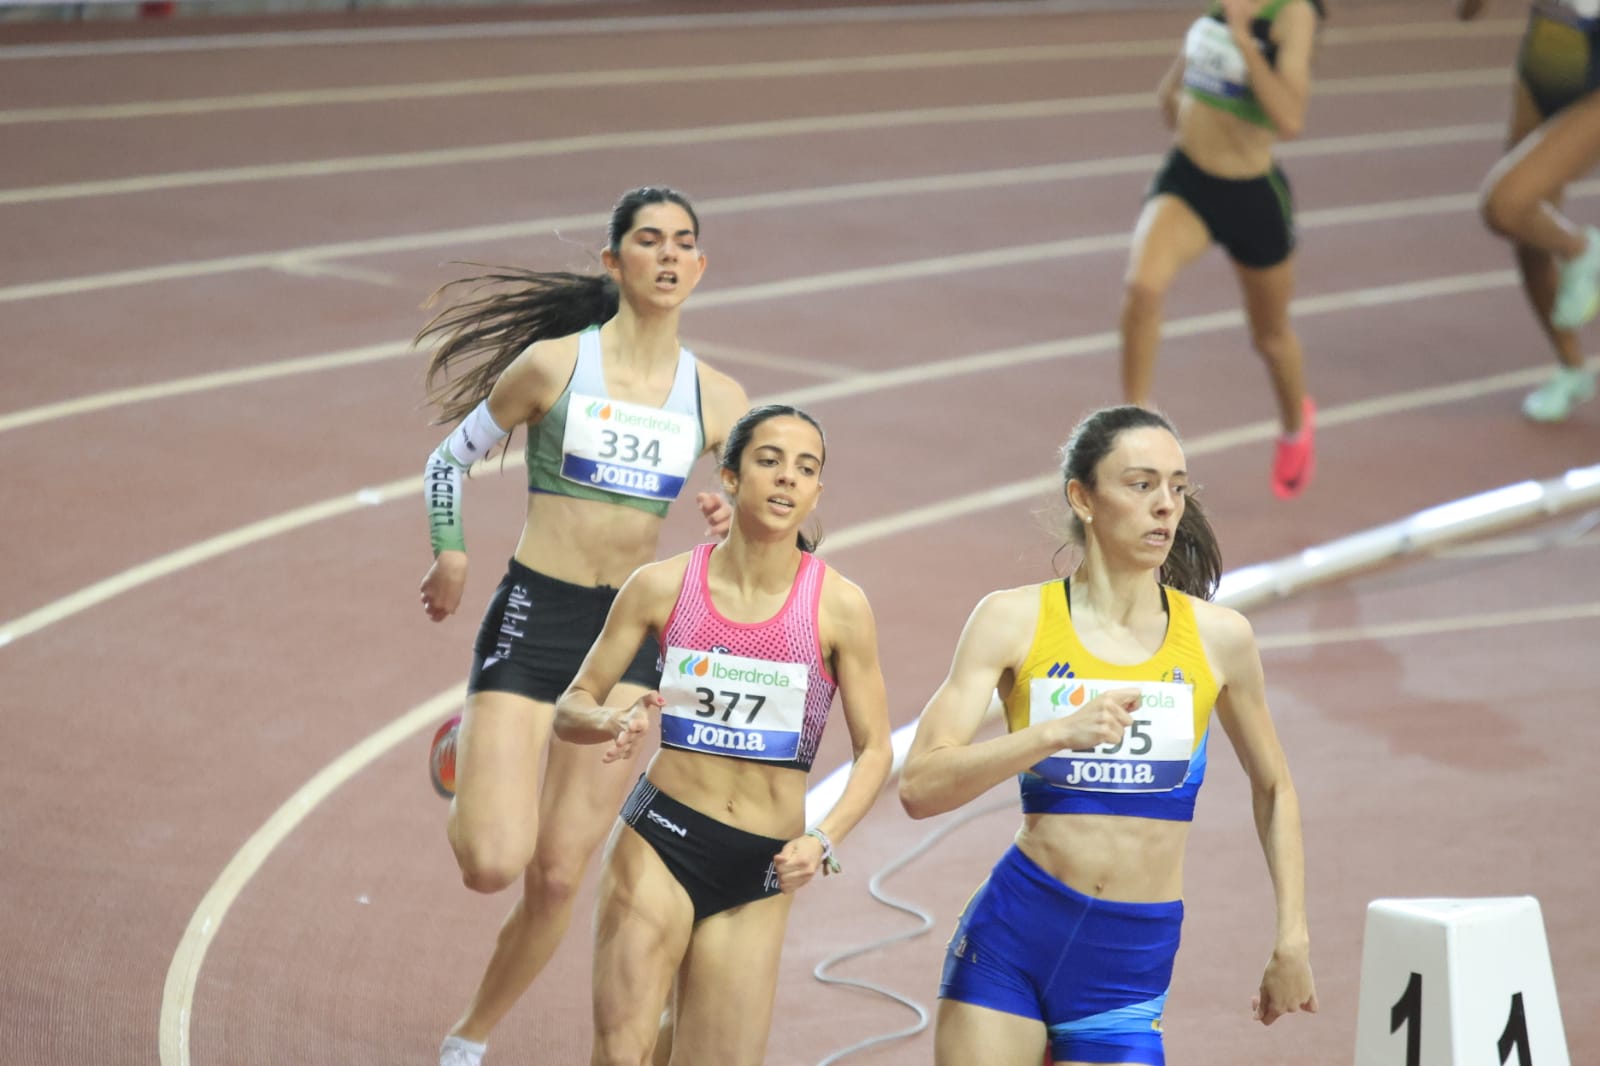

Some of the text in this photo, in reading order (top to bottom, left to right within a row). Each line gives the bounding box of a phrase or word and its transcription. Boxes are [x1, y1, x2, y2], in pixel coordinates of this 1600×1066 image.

[614, 409, 681, 434] Iberdrola
[598, 429, 662, 467] 334
[711, 662, 790, 688] Iberdrola
[695, 687, 767, 725] 377
[1389, 971, 1423, 1066] 1
[1497, 991, 1533, 1066] 1
